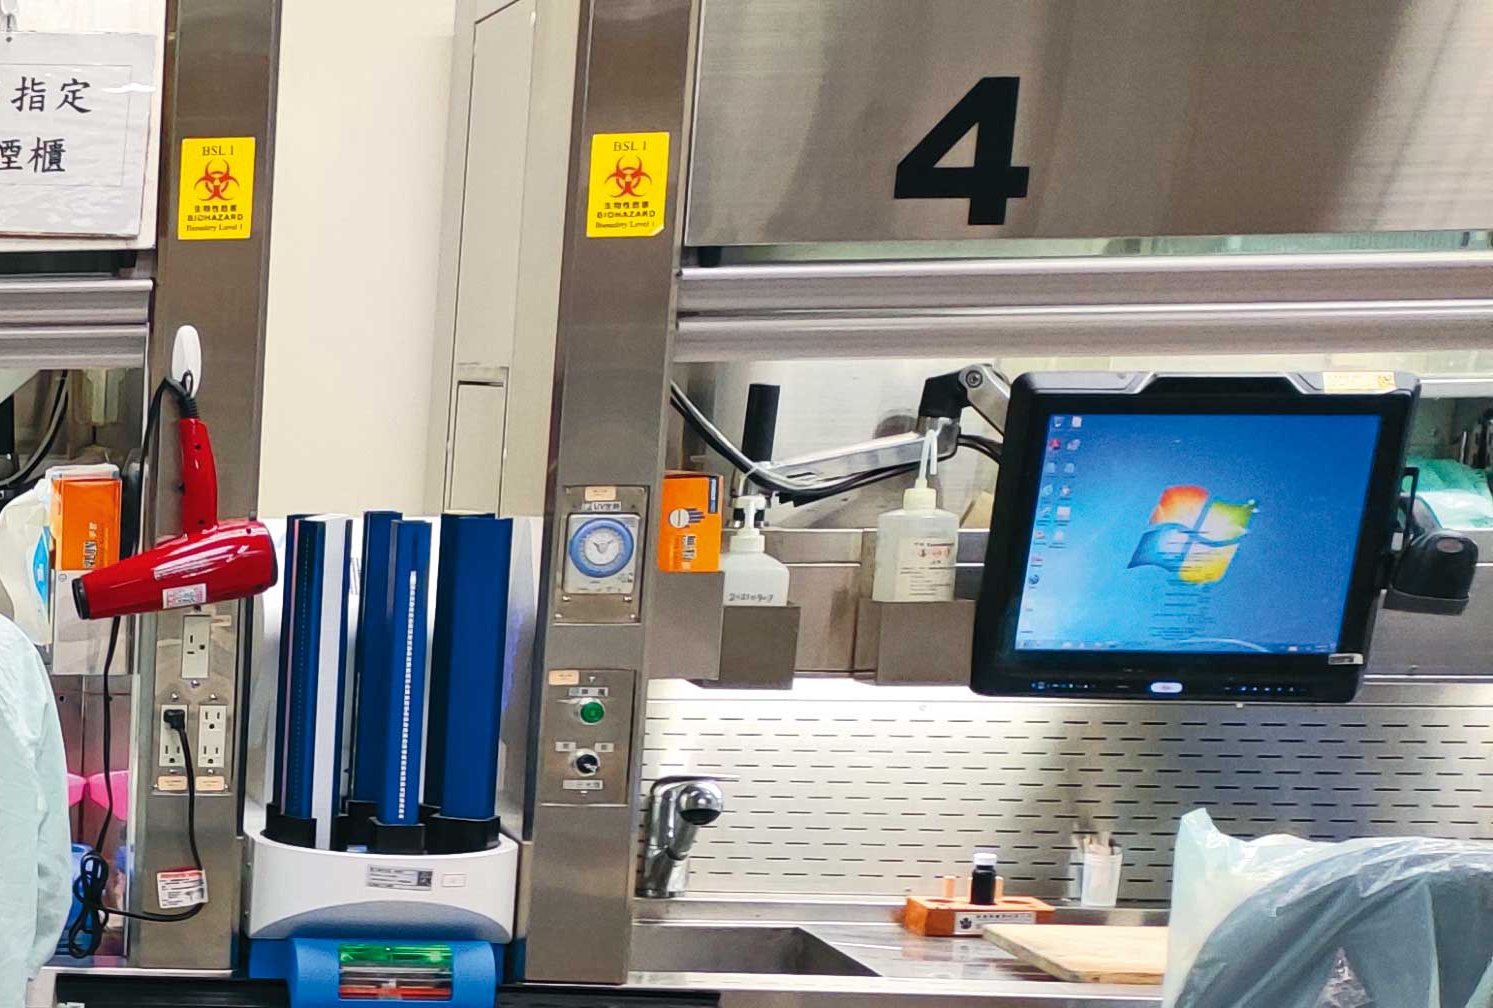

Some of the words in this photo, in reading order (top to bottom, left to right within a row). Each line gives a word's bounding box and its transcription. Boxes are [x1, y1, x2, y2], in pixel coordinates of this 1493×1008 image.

[202, 145, 226, 156] BSL
[613, 140, 638, 152] BSL
[894, 76, 1030, 226] 4
[187, 213, 244, 222] BIOHAZARD
[596, 210, 656, 219] BIOHAZARD
